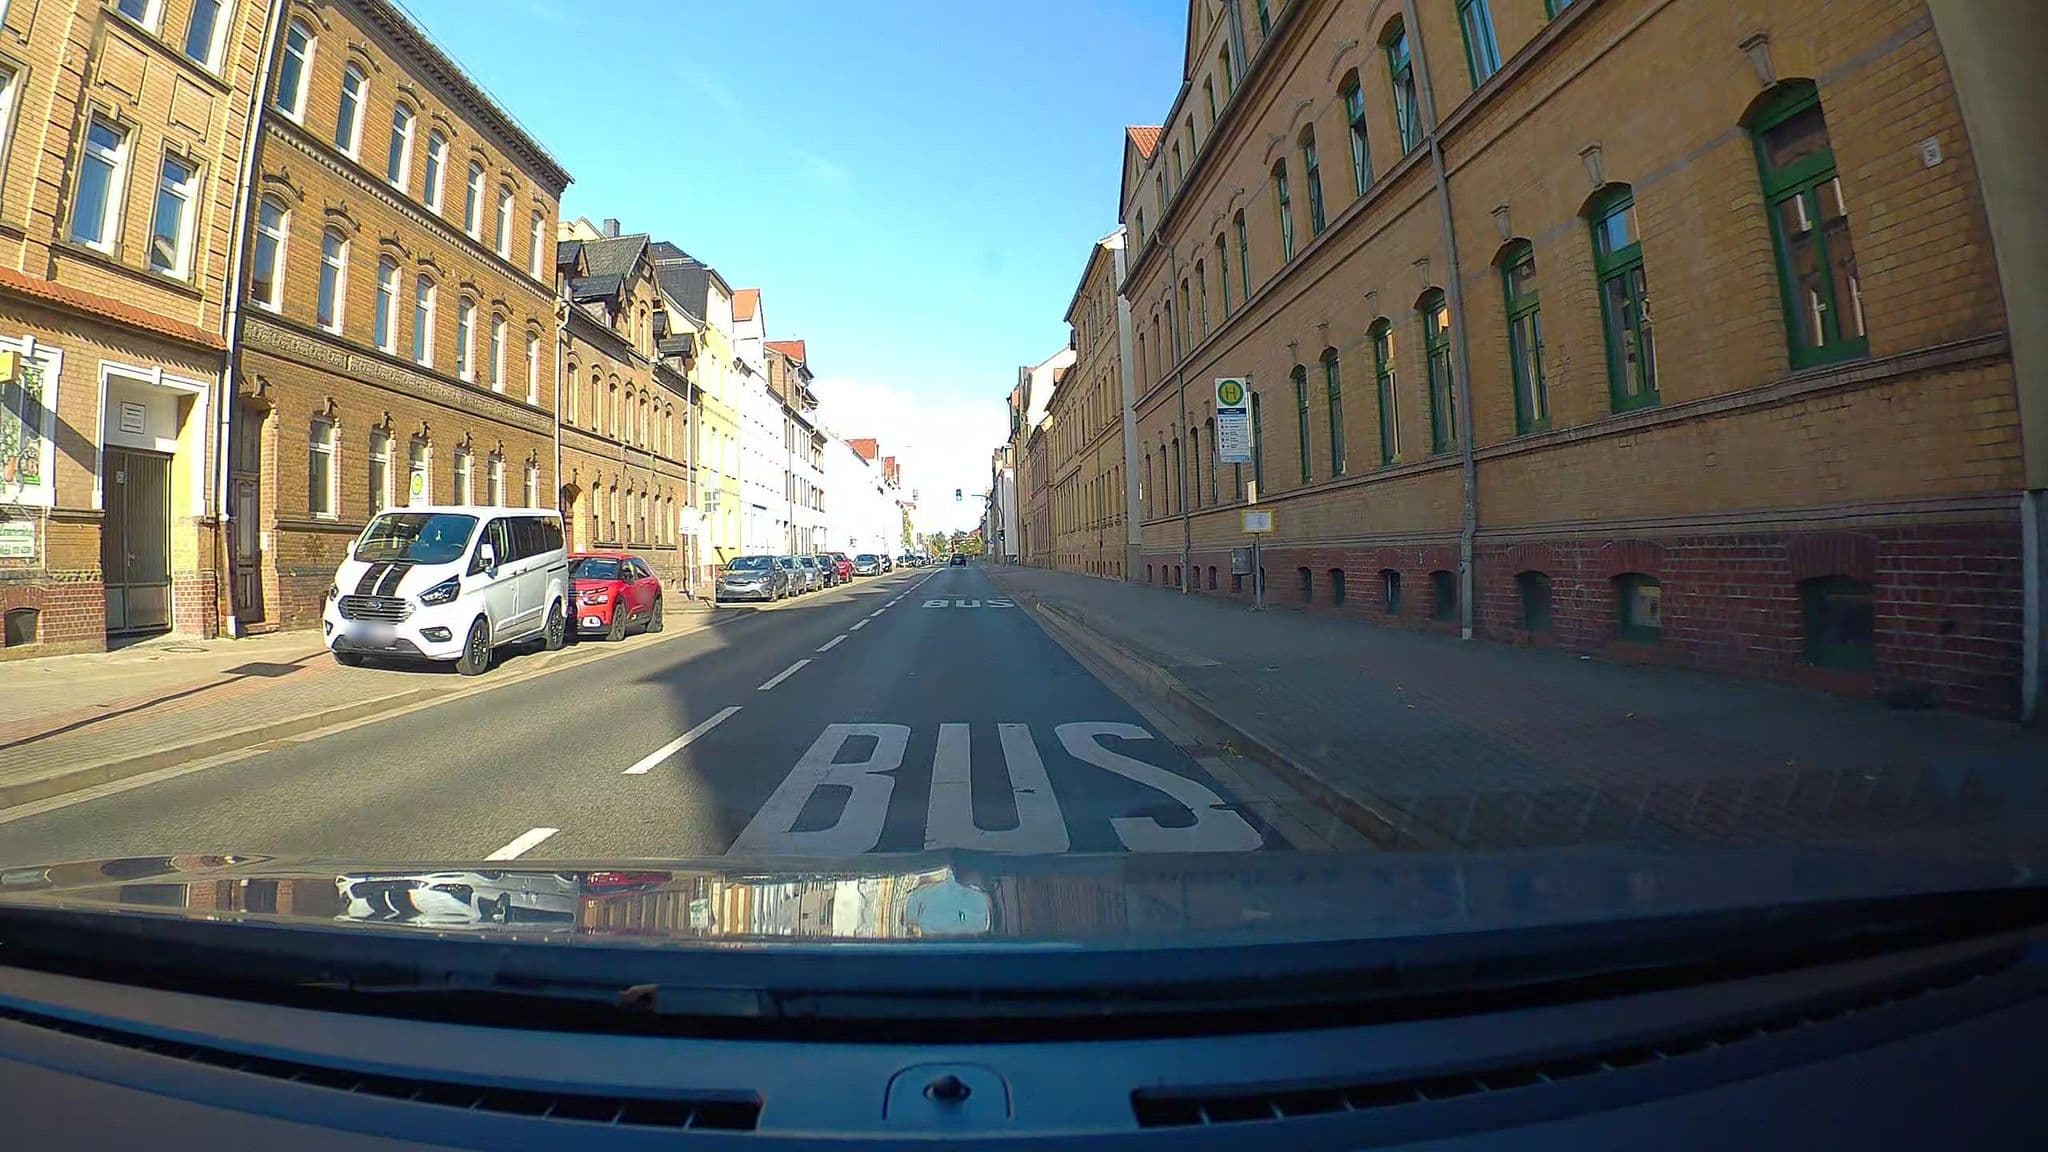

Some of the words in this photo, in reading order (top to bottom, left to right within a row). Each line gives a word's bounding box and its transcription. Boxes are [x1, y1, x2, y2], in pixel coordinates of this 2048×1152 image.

[1225, 384, 1237, 401] H
[922, 600, 1015, 608] BUS
[724, 721, 1265, 854] BUS
